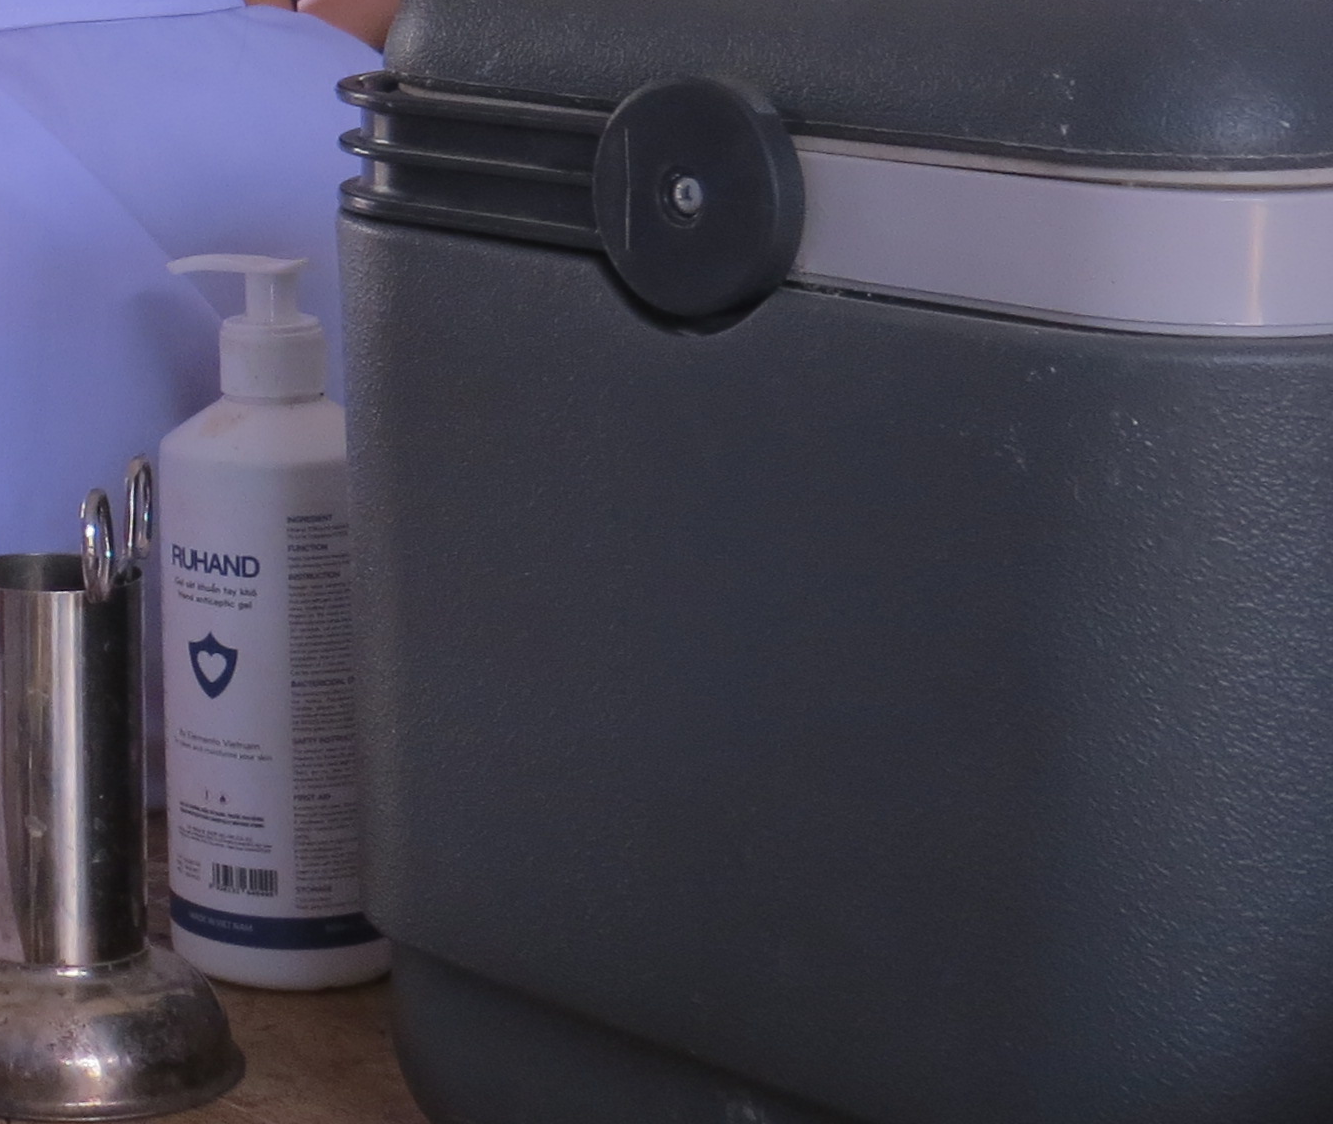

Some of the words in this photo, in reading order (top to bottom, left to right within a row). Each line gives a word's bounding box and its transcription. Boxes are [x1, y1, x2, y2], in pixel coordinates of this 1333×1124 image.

[288, 543, 328, 552] FUNCTION
[171, 543, 261, 578] RUHAND
[288, 571, 340, 581] INSTRUCTION
[238, 601, 252, 611] gel
[222, 738, 261, 751] Vietnam
